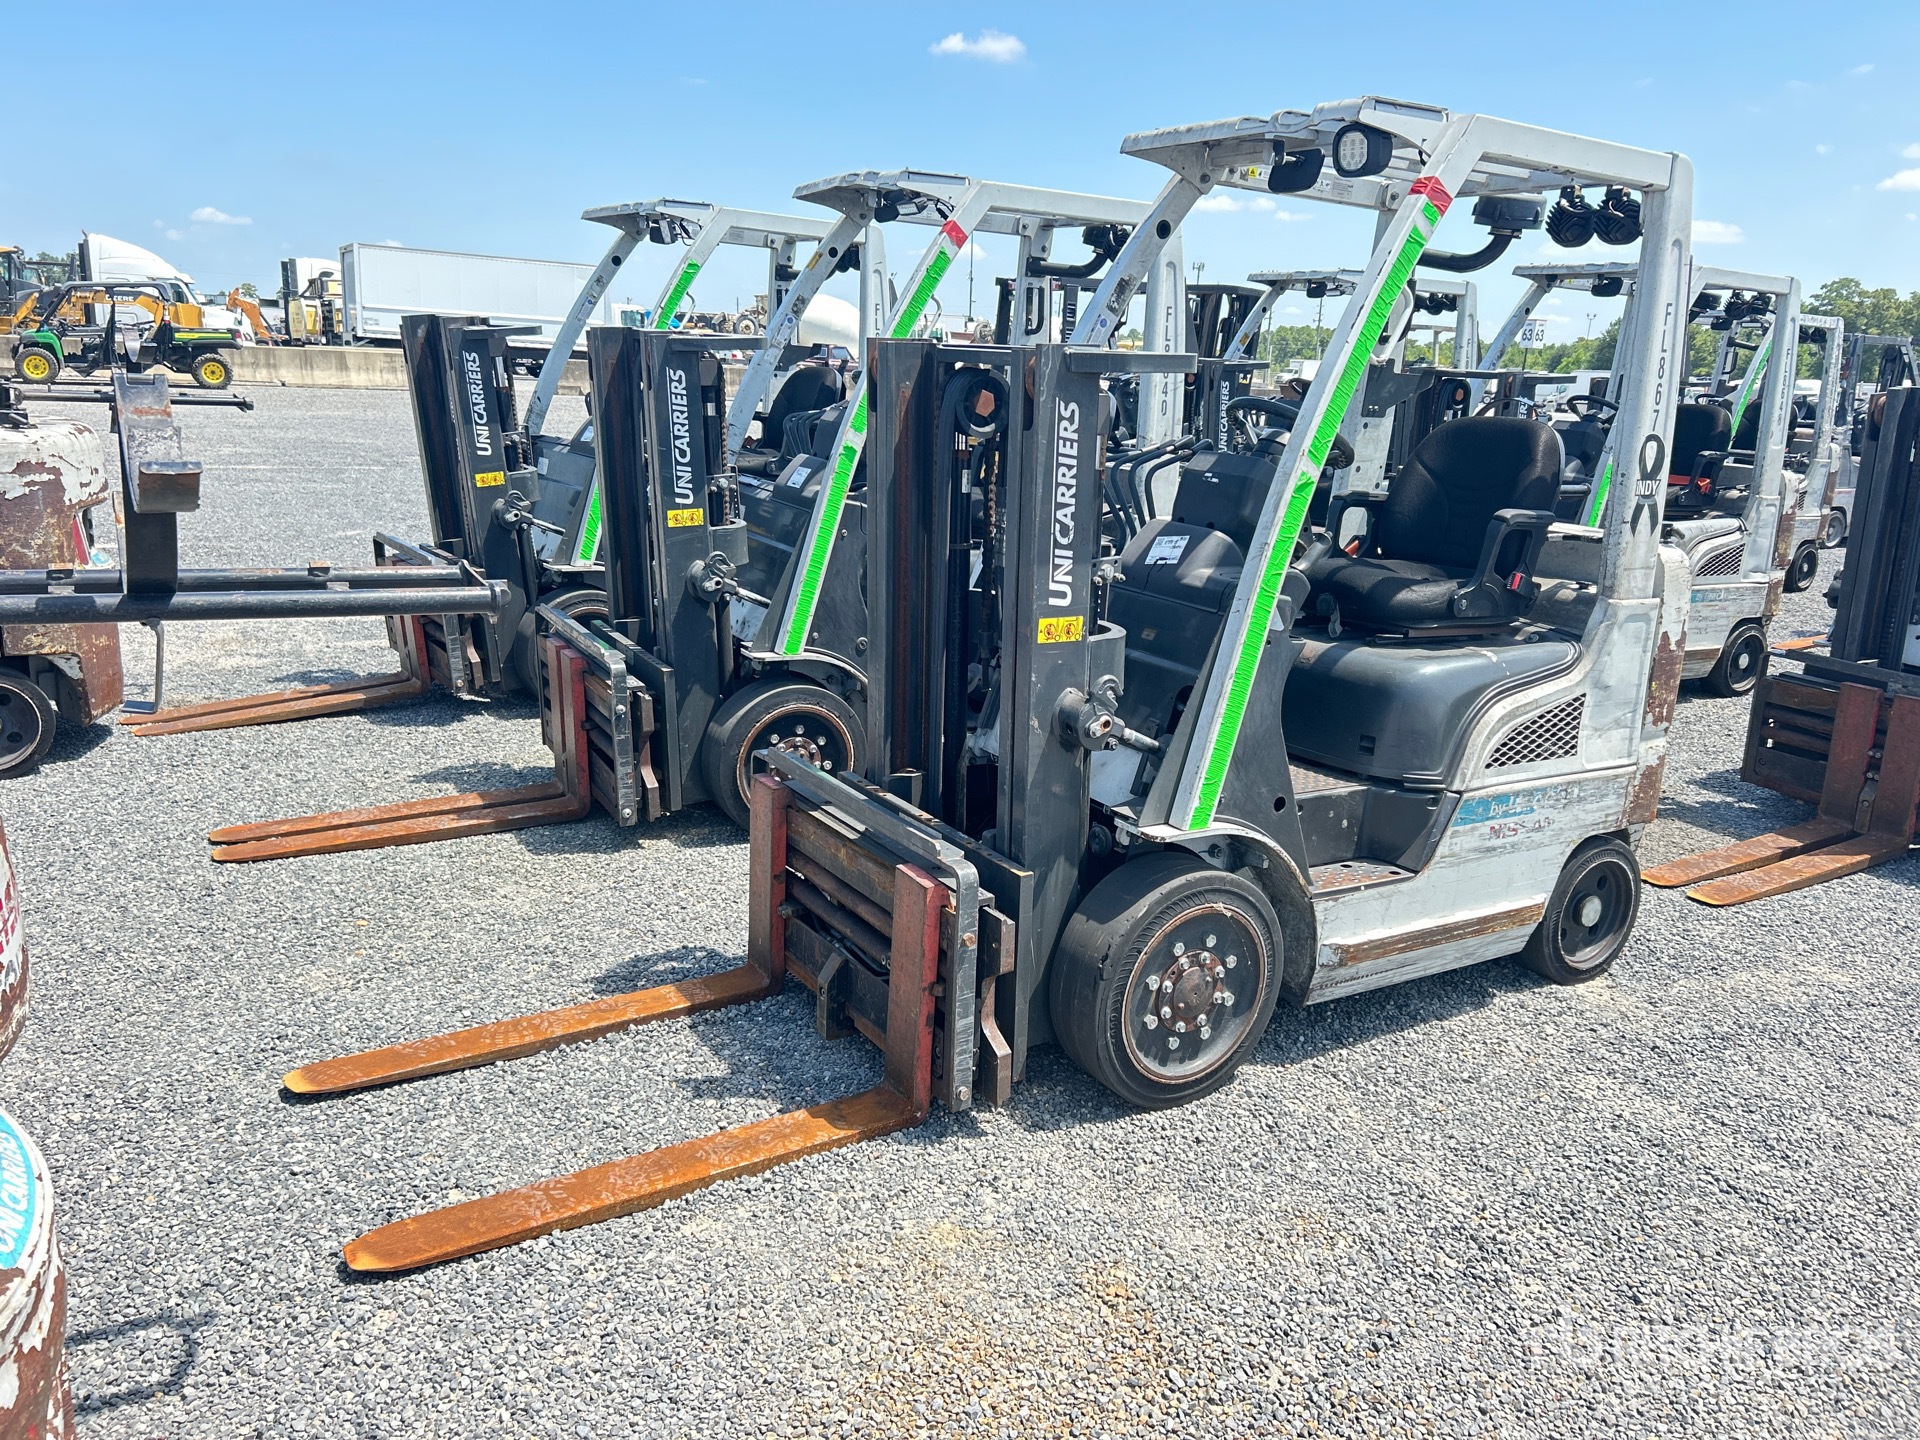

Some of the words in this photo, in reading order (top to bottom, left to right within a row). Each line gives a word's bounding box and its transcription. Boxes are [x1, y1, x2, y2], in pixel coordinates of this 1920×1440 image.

[1522, 328, 1533, 341] 63
[1535, 329, 1545, 341] 63
[1653, 303, 1673, 432] FL867
[463, 351, 492, 456] UNICARRIERS
[666, 367, 694, 505] UNICARRIERS
[1048, 397, 1080, 607] UNICARRIERS
